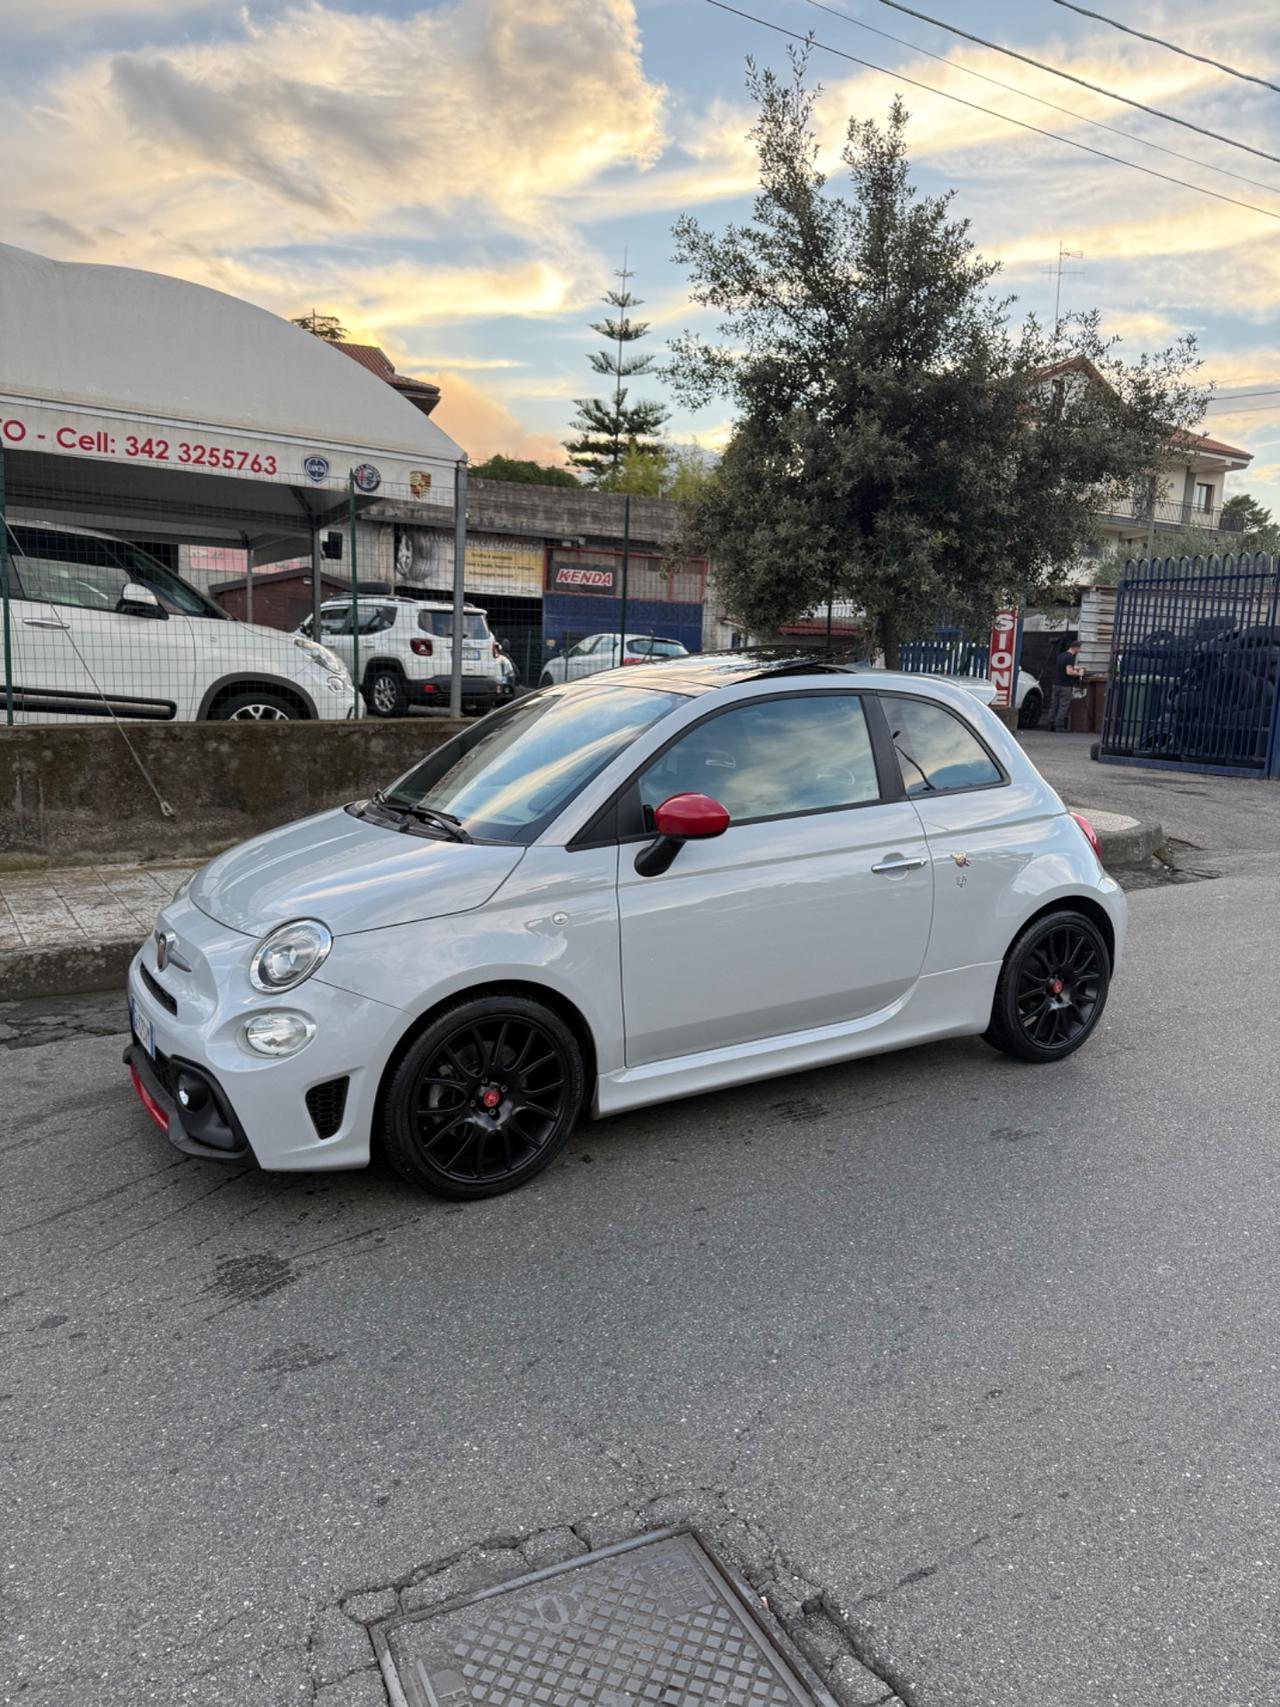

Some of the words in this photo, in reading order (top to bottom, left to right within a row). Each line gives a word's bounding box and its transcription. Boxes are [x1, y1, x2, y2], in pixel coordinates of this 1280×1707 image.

[0, 419, 26, 442] O
[56, 427, 116, 454] Cell:
[125, 436, 169, 460] 342
[178, 442, 278, 475] 3255763
[556, 568, 613, 587] KENDA
